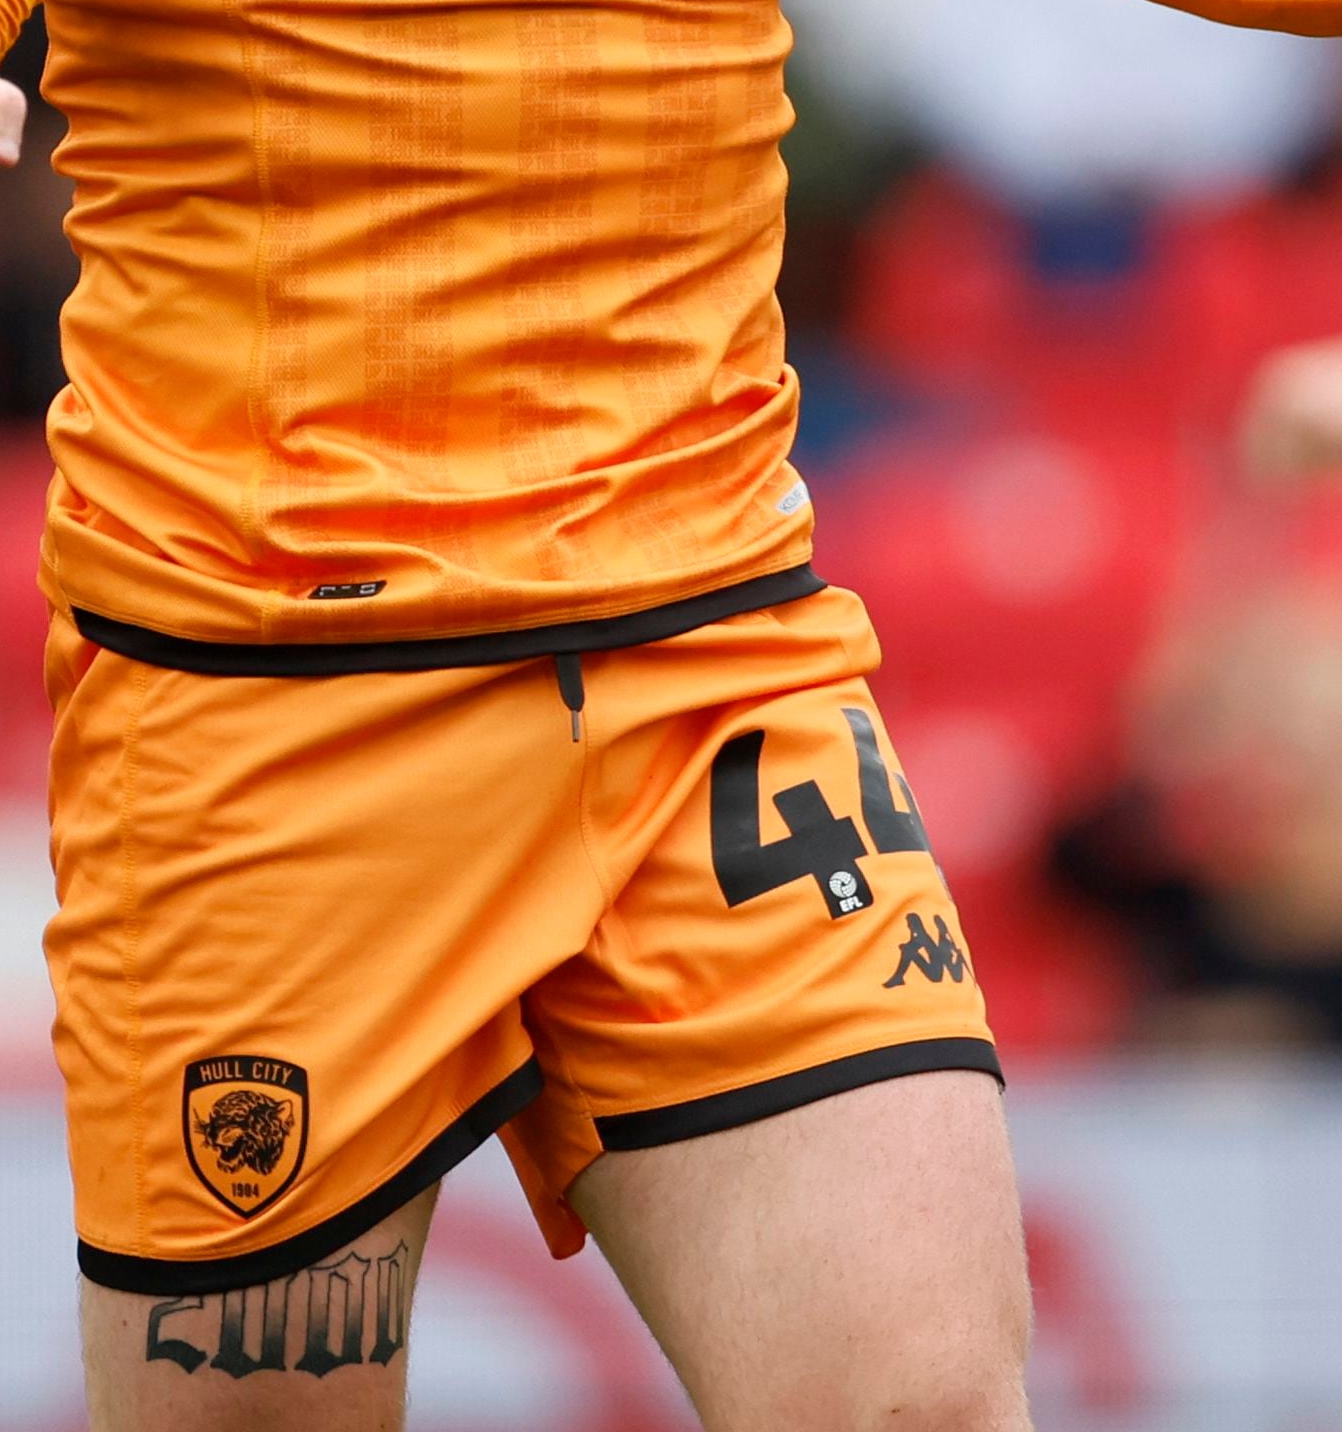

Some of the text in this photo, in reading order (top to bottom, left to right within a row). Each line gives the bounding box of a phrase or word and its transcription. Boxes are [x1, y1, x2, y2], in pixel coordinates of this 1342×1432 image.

[838, 895, 863, 913] EFL
[199, 1060, 294, 1085] HULL CITY
[231, 1183, 260, 1198] 1904
